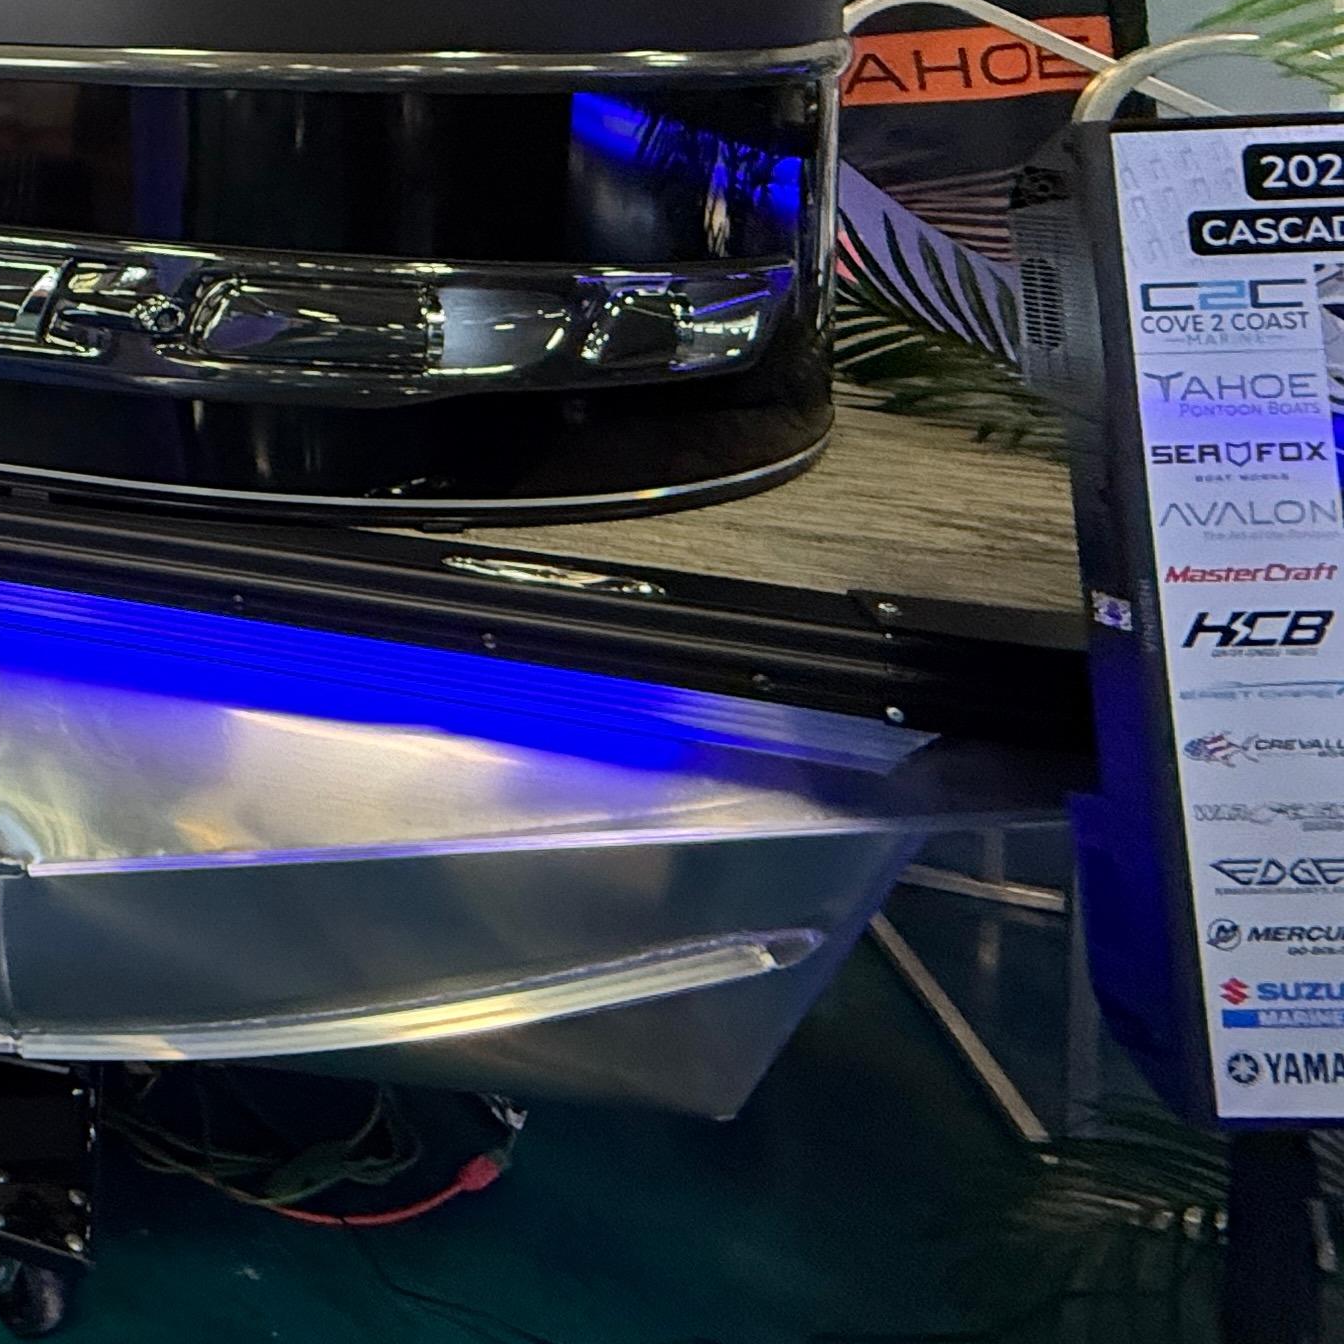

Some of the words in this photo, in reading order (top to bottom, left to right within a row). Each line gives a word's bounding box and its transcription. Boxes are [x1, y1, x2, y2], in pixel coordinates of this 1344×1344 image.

[844, 35, 1095, 95] AHOE
[1140, 278, 1307, 312] C2C
[1140, 314, 1205, 334] COVE
[1211, 314, 1224, 332] 2
[1230, 311, 1310, 332] COAST
[1143, 371, 1319, 402] TAHOE
[1178, 403, 1263, 417] PONTOON
[1268, 401, 1321, 415] BOATS
[1150, 444, 1223, 464] SEA
[1256, 442, 1329, 462] FOX
[1159, 500, 1338, 527] AVALON
[1164, 562, 1338, 583] MasterCraft
[1181, 610, 1335, 648] HCB
